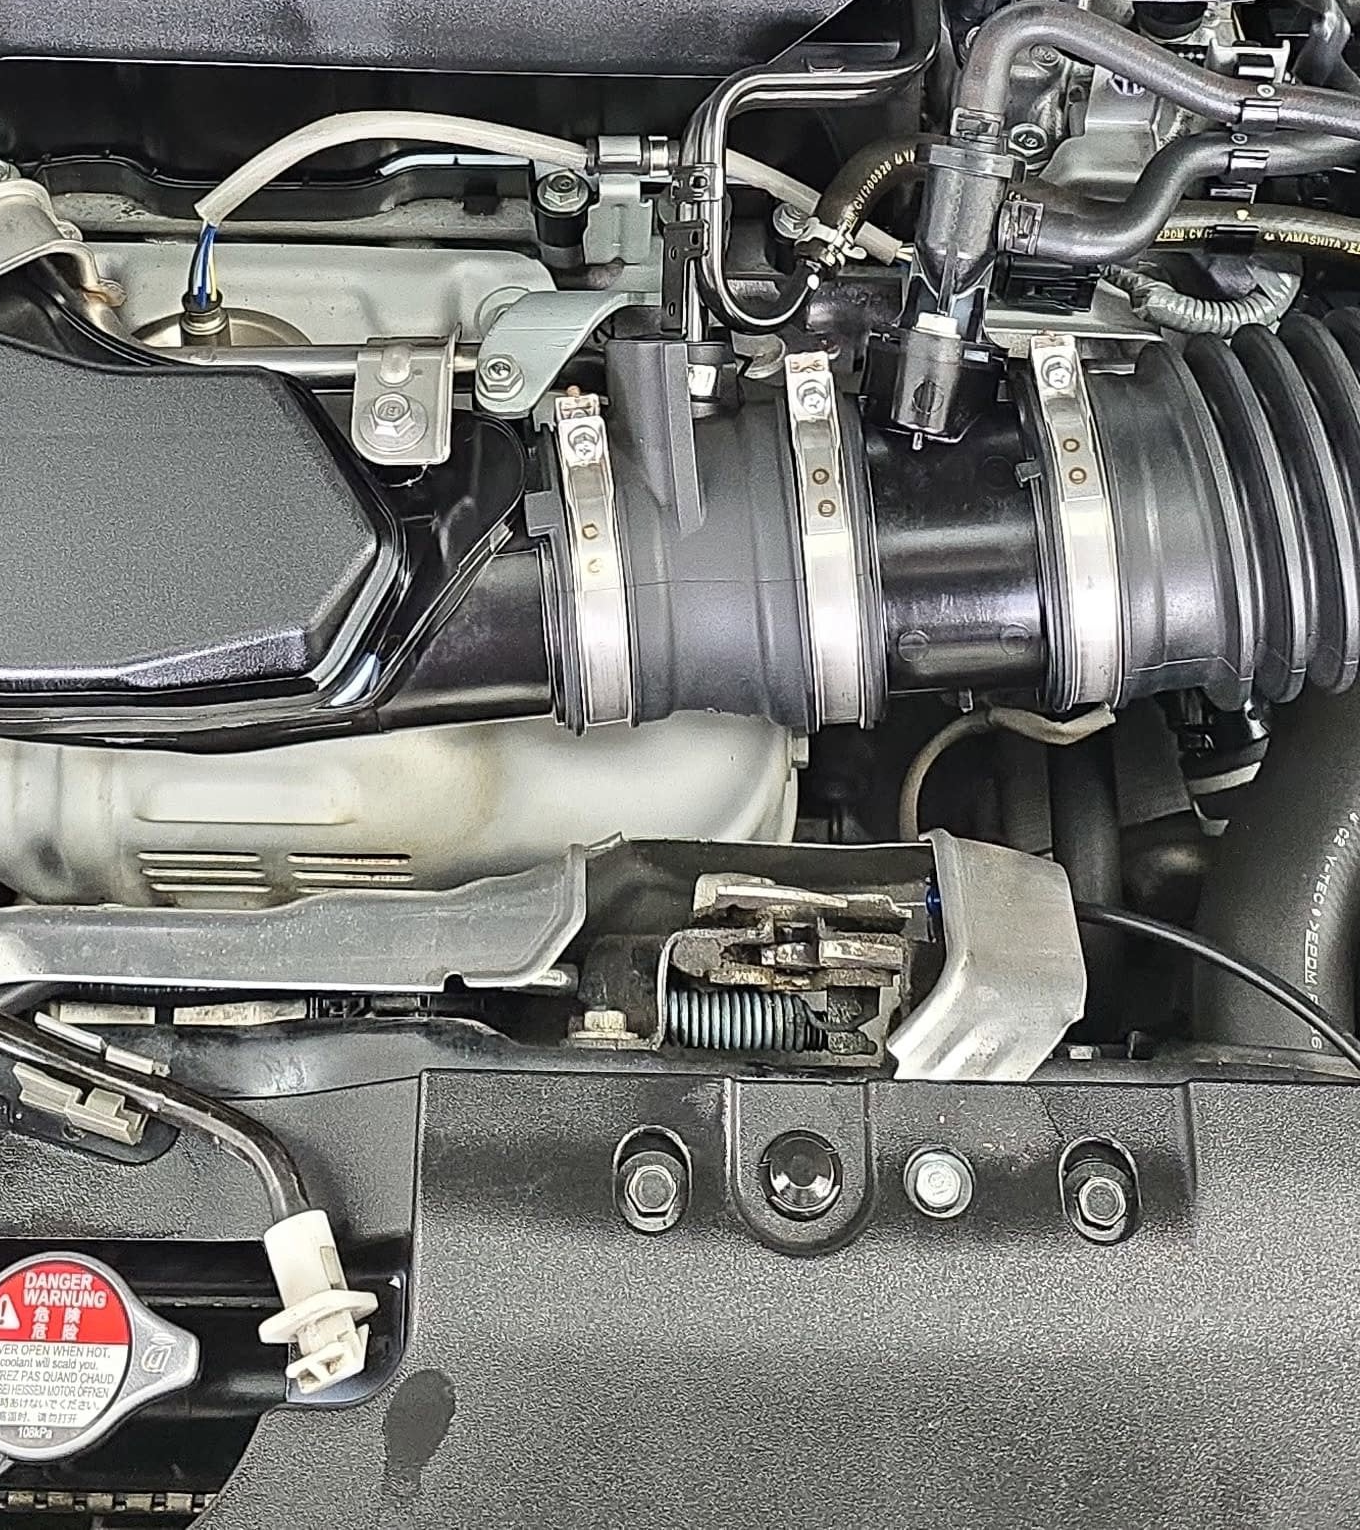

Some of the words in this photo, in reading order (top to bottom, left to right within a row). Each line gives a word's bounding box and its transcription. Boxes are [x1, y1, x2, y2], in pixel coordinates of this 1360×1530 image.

[1278, 231, 1342, 250] YAMASHITA
[25, 1271, 93, 1290] DANGER
[23, 1289, 107, 1308] WARNUNG
[21, 1345, 49, 1357] OPEN
[53, 1346, 85, 1358] WHEN
[87, 1347, 111, 1359] HOT.
[0, 1357, 33, 1368] coolant
[35, 1358, 51, 1369] will
[52, 1359, 77, 1370] scald
[80, 1361, 98, 1373] you.
[21, 1371, 41, 1382] PAS
[43, 1372, 79, 1383] QUAND
[50, 1385, 77, 1397] MOTOR
